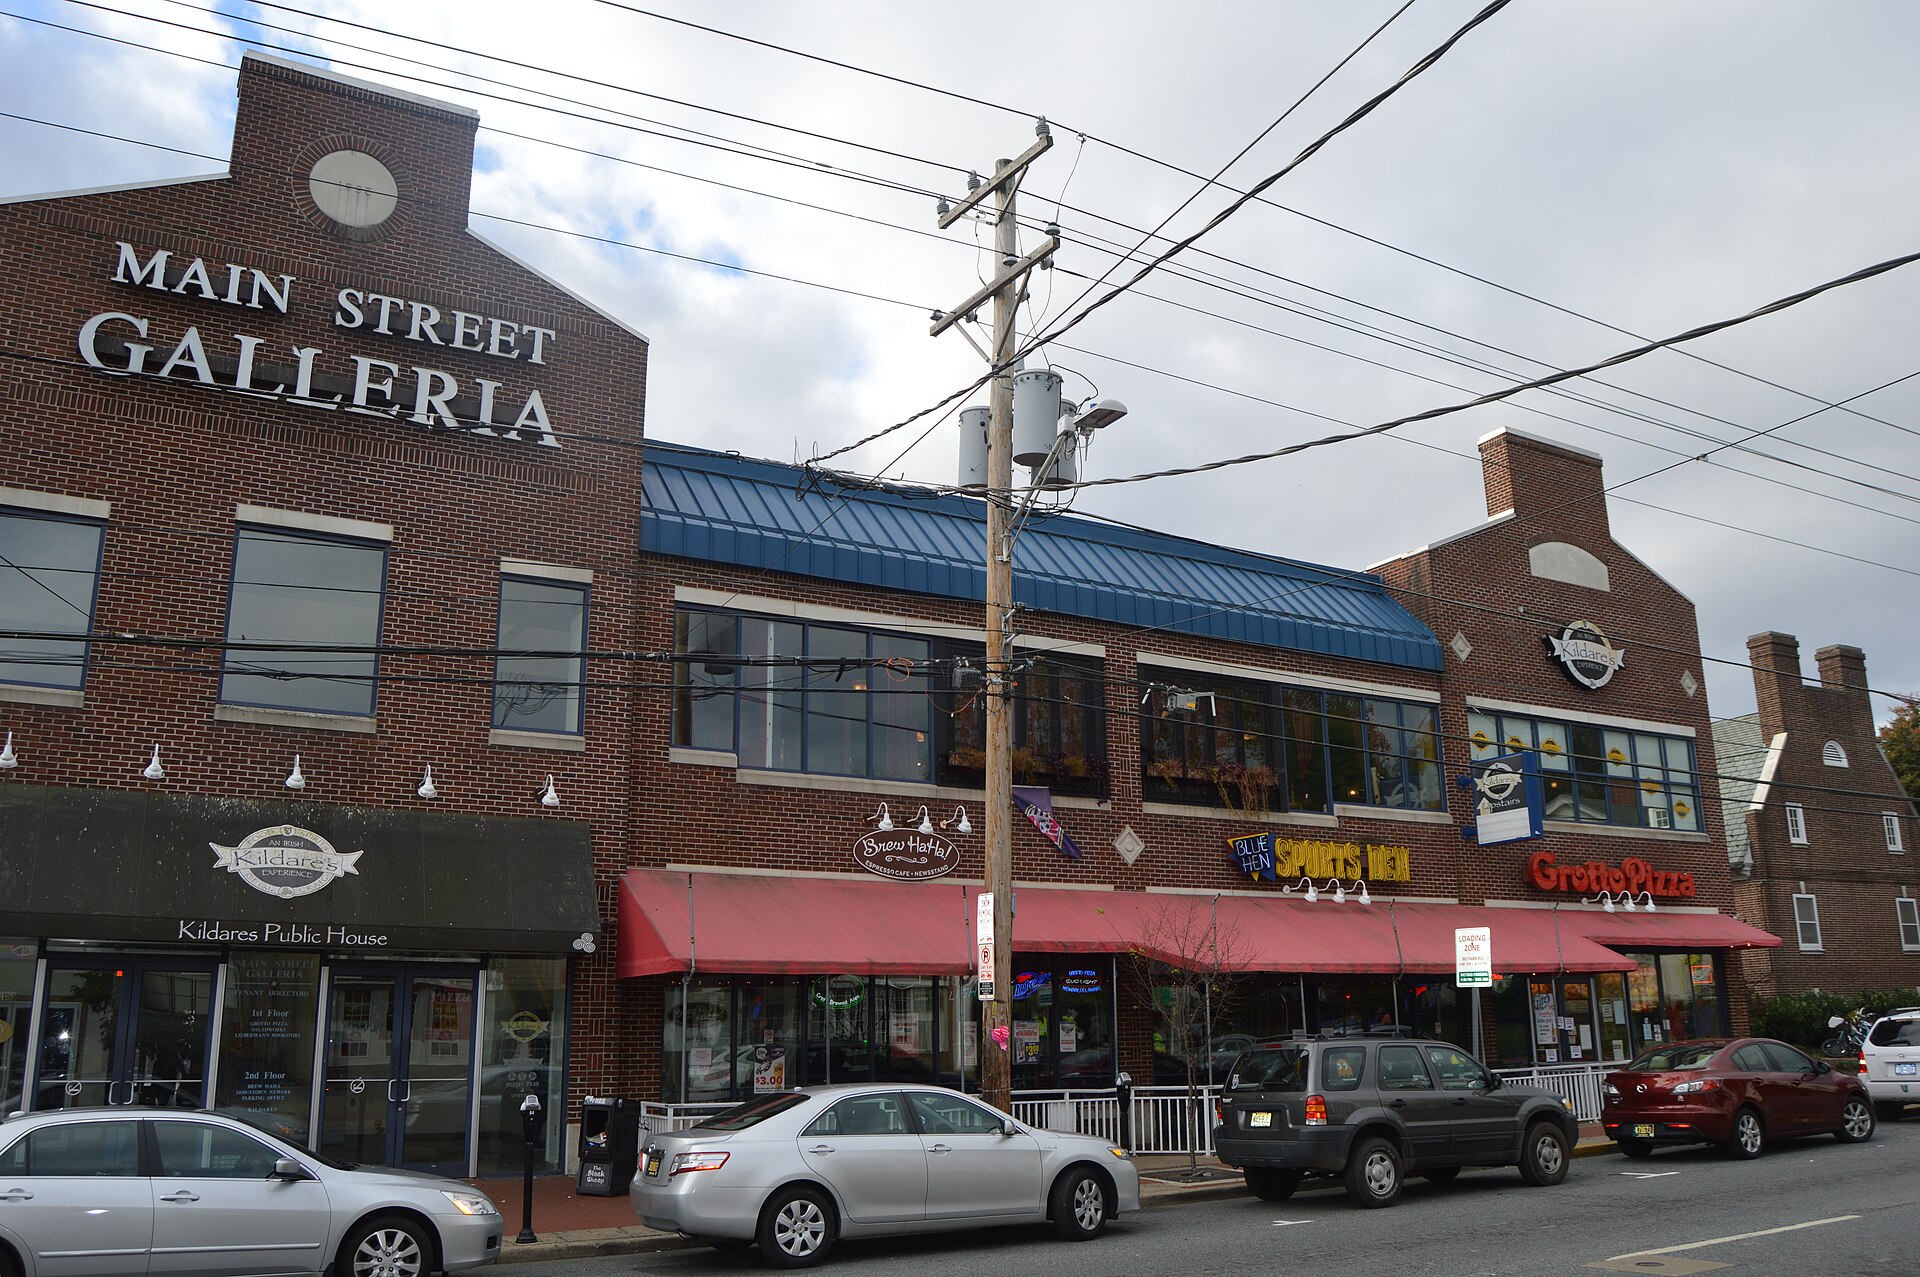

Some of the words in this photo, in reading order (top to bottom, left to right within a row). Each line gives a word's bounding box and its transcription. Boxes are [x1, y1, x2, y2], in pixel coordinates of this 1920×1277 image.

[110, 241, 296, 314] MAIN
[335, 288, 556, 365] STREET
[78, 312, 562, 448] GALLERIA
[1560, 641, 1616, 666] Kildare's
[269, 839, 281, 847] AN
[283, 840, 304, 848] IRISH
[862, 837, 905, 857] Brew
[907, 835, 953, 861] HaHa!
[1235, 835, 1268, 857] BLUE
[234, 849, 338, 872] Kildare's
[865, 860, 895, 875] ESPRESSO
[914, 864, 949, 877] NEWSSTAND
[1242, 852, 1271, 873] HEN
[1275, 838, 1362, 880] SPORTS
[1367, 843, 1411, 882] DEN
[262, 869, 313, 878] EXPERIENCE
[1529, 851, 1627, 894] Grotto
[1622, 856, 1696, 897] Pizza
[178, 920, 258, 942] Kildares
[264, 923, 322, 944] Public
[326, 925, 388, 946] House
[235, 959, 267, 968] MAIN
[274, 960, 314, 968] STREET
[246, 969, 303, 978] GALLERIA
[252, 1009, 263, 1017] 1st
[267, 1009, 289, 1017] Floor
[244, 1071, 259, 1079] 2nd
[264, 1071, 286, 1079] Floor
[755, 1076, 783, 1085] $3.00
[587, 1170, 605, 1178] Black
